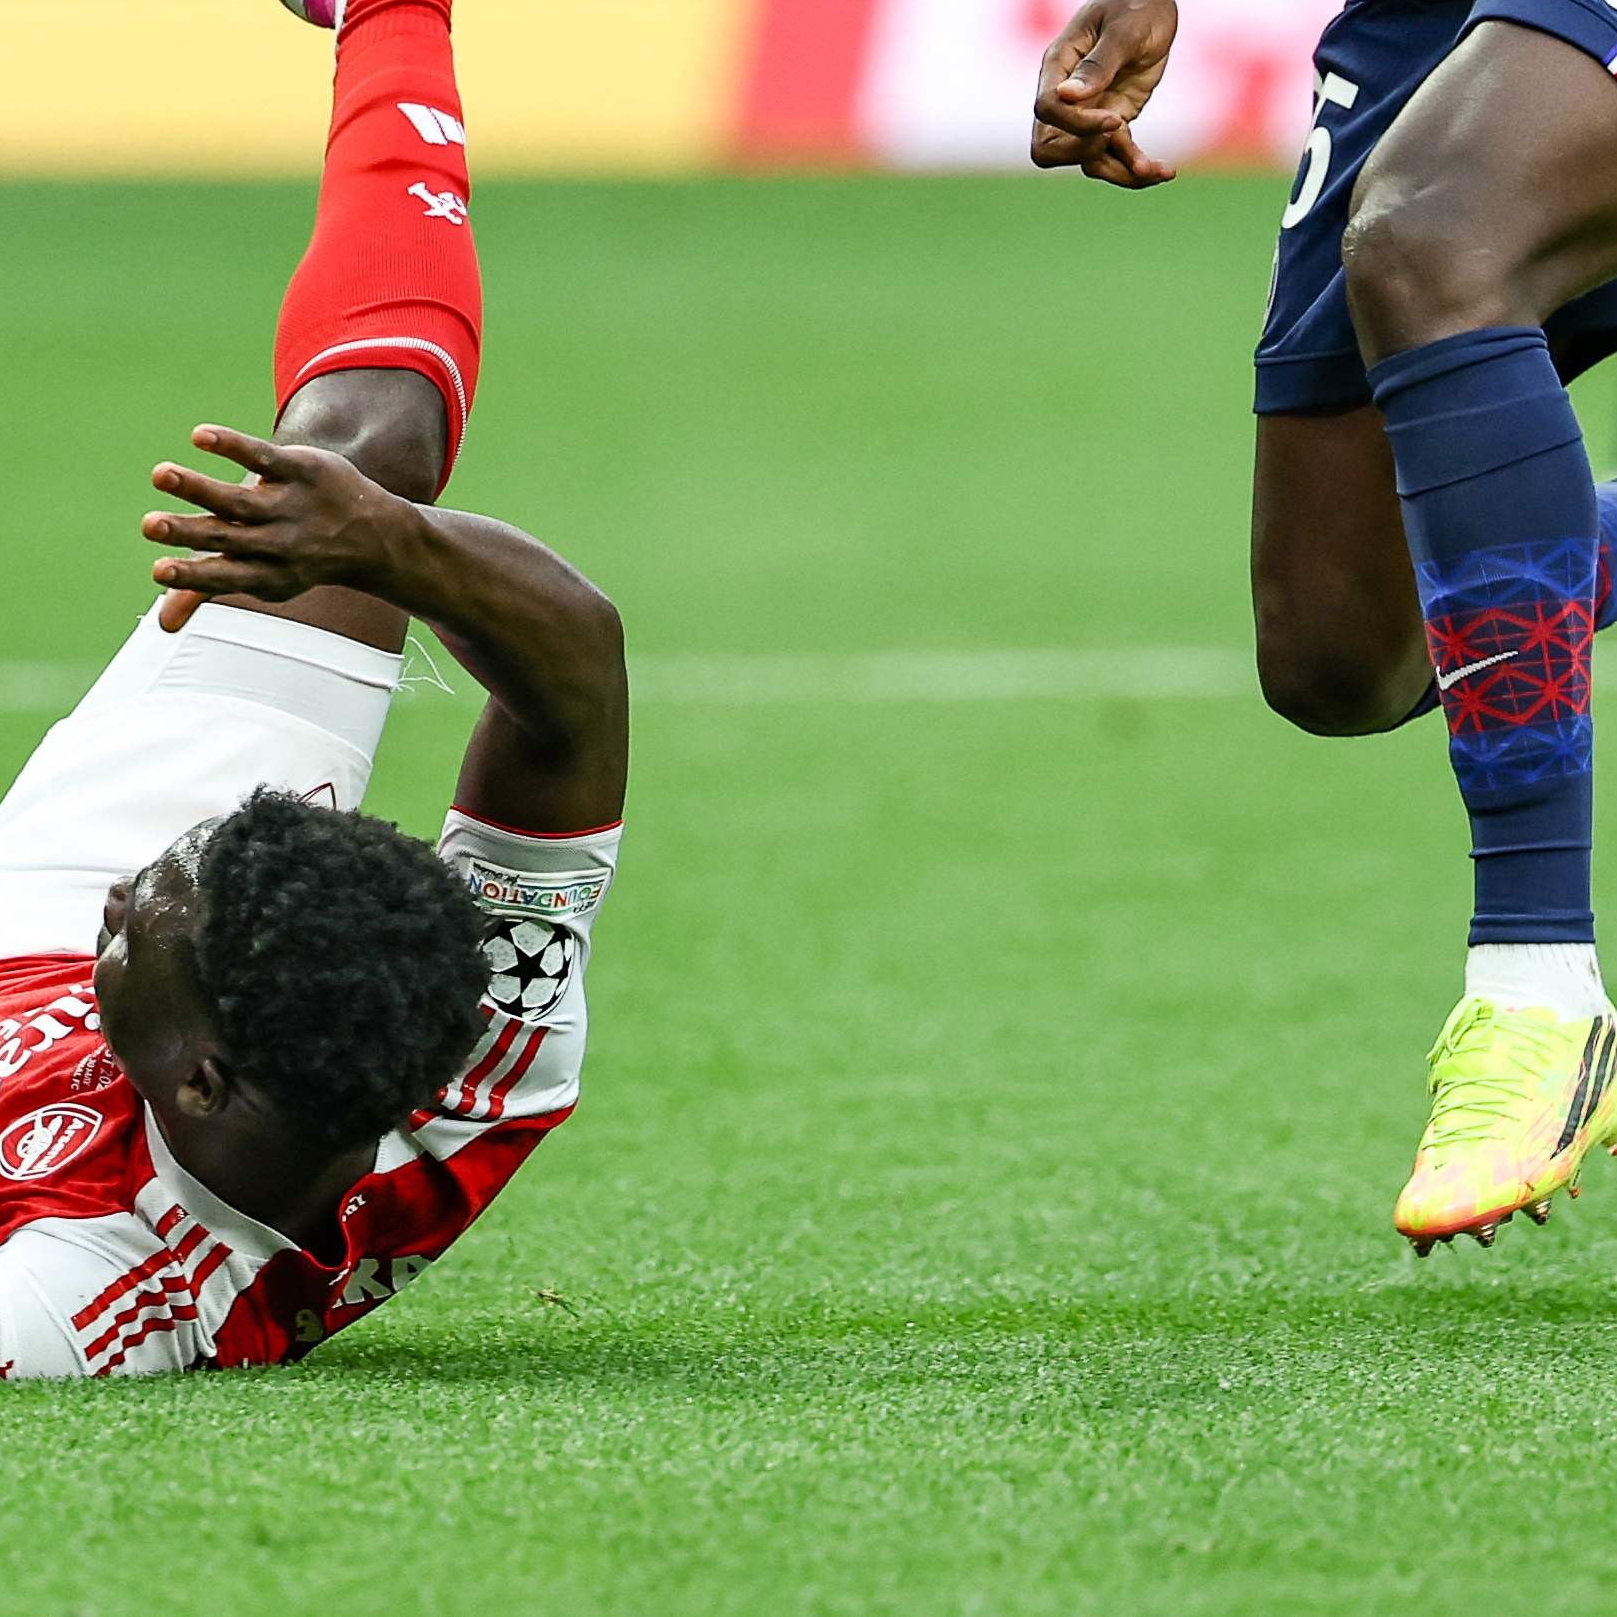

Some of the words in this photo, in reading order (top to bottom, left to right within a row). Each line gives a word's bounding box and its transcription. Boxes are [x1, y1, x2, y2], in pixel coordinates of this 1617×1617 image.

[1281, 69, 1359, 230] 5
[469, 873, 603, 909] FOUNDATION
[30, 1117, 84, 1170] Arsenal
